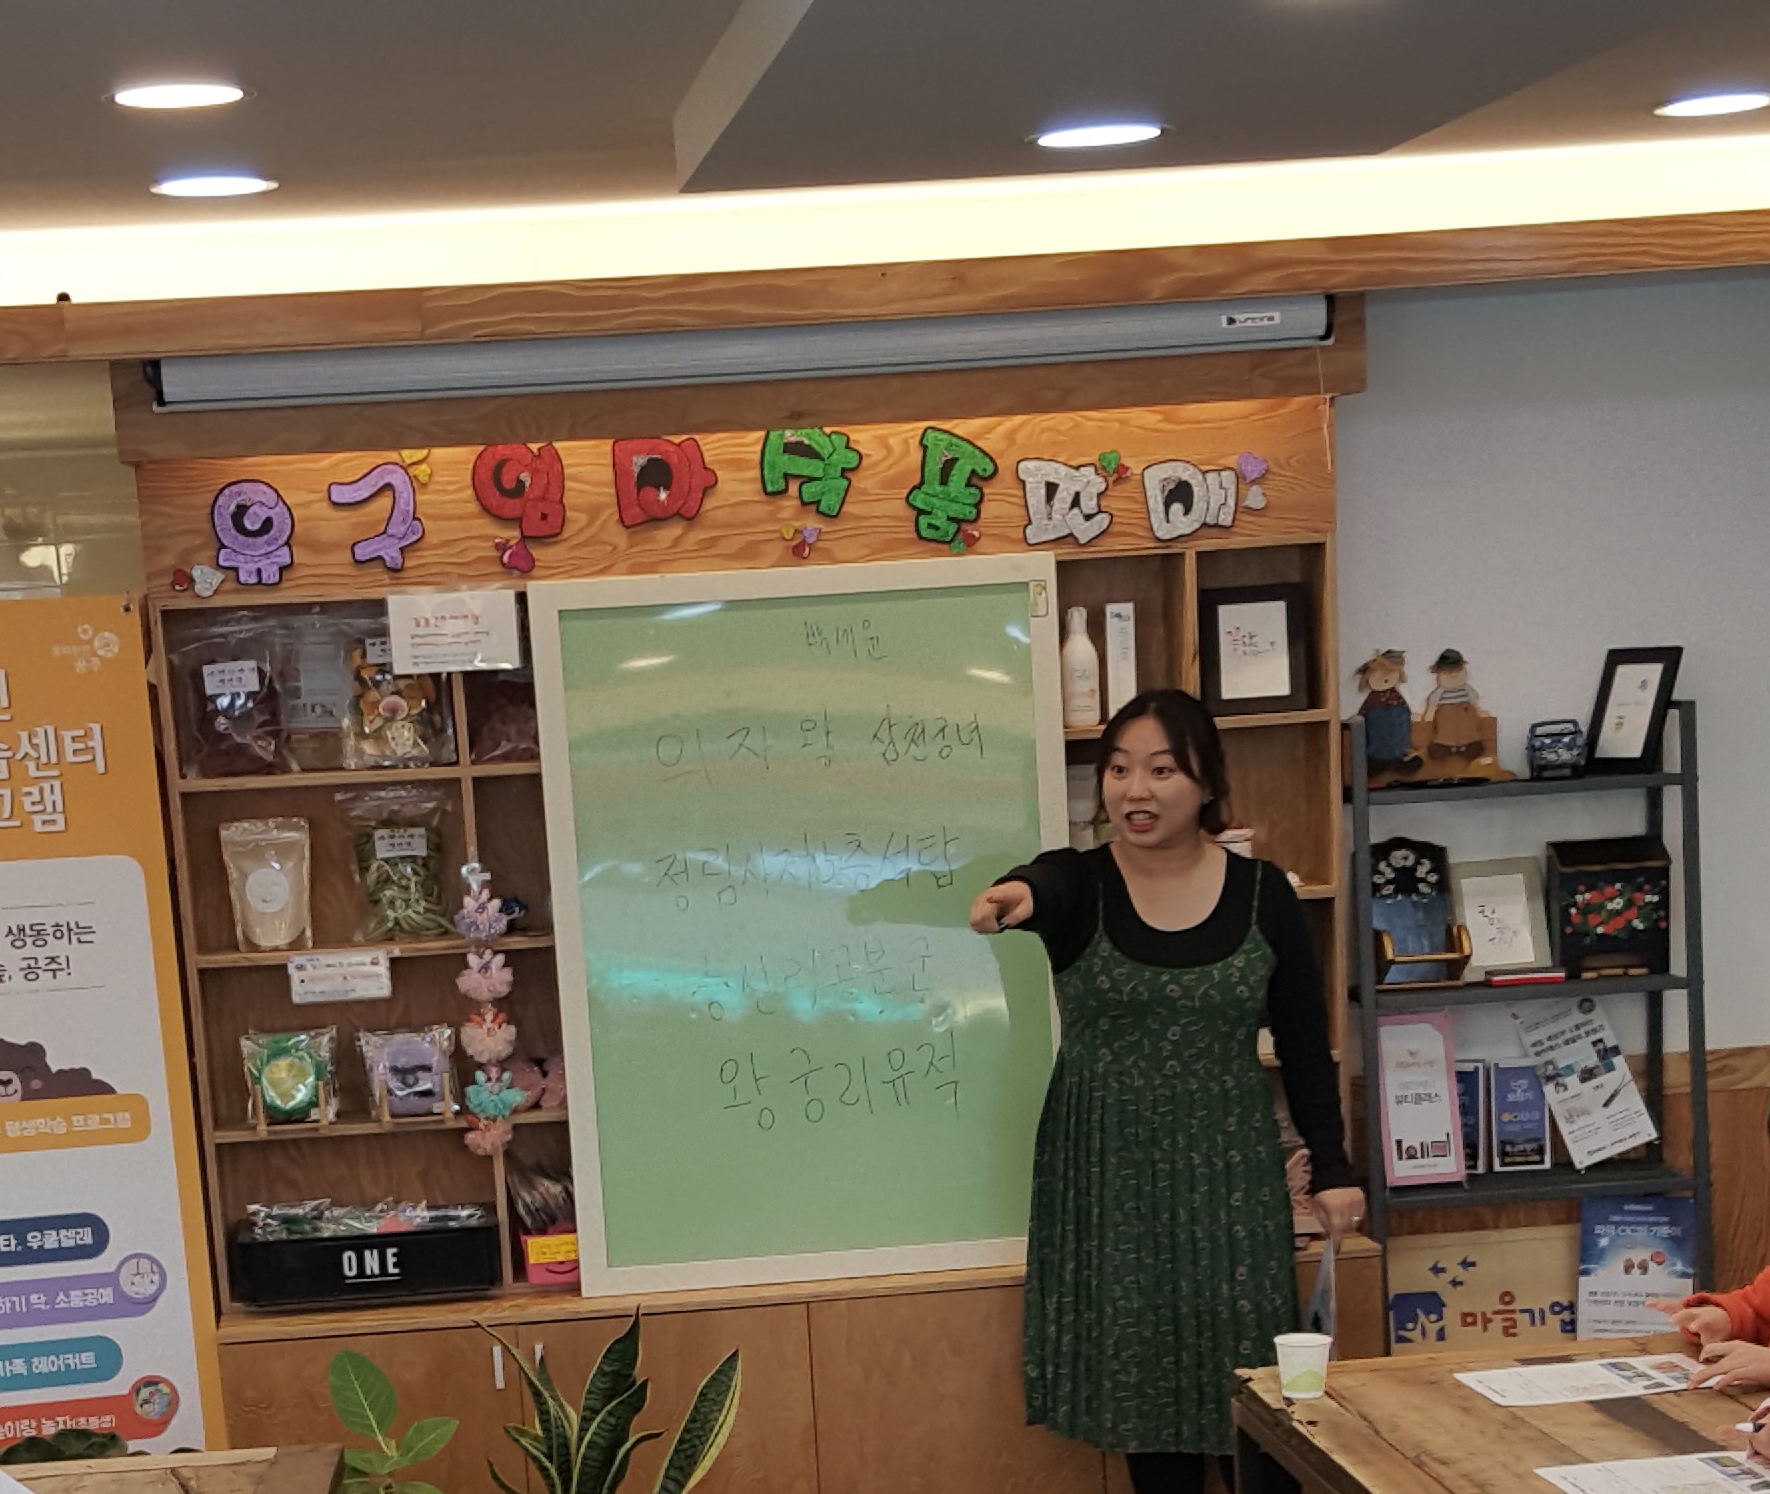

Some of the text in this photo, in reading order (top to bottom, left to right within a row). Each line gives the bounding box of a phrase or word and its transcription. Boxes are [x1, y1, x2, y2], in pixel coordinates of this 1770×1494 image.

[1017, 458, 1239, 545] 판매
[5, 920, 97, 950] 생동하는
[19, 955, 72, 982] 공주!
[719, 1031, 960, 1131] 왕궁리유적
[71, 1111, 132, 1131] 프로그램
[342, 1247, 400, 1277] ONE
[1460, 1290, 1575, 1338] 마을기업
[31, 1351, 98, 1376] 헤어커트
